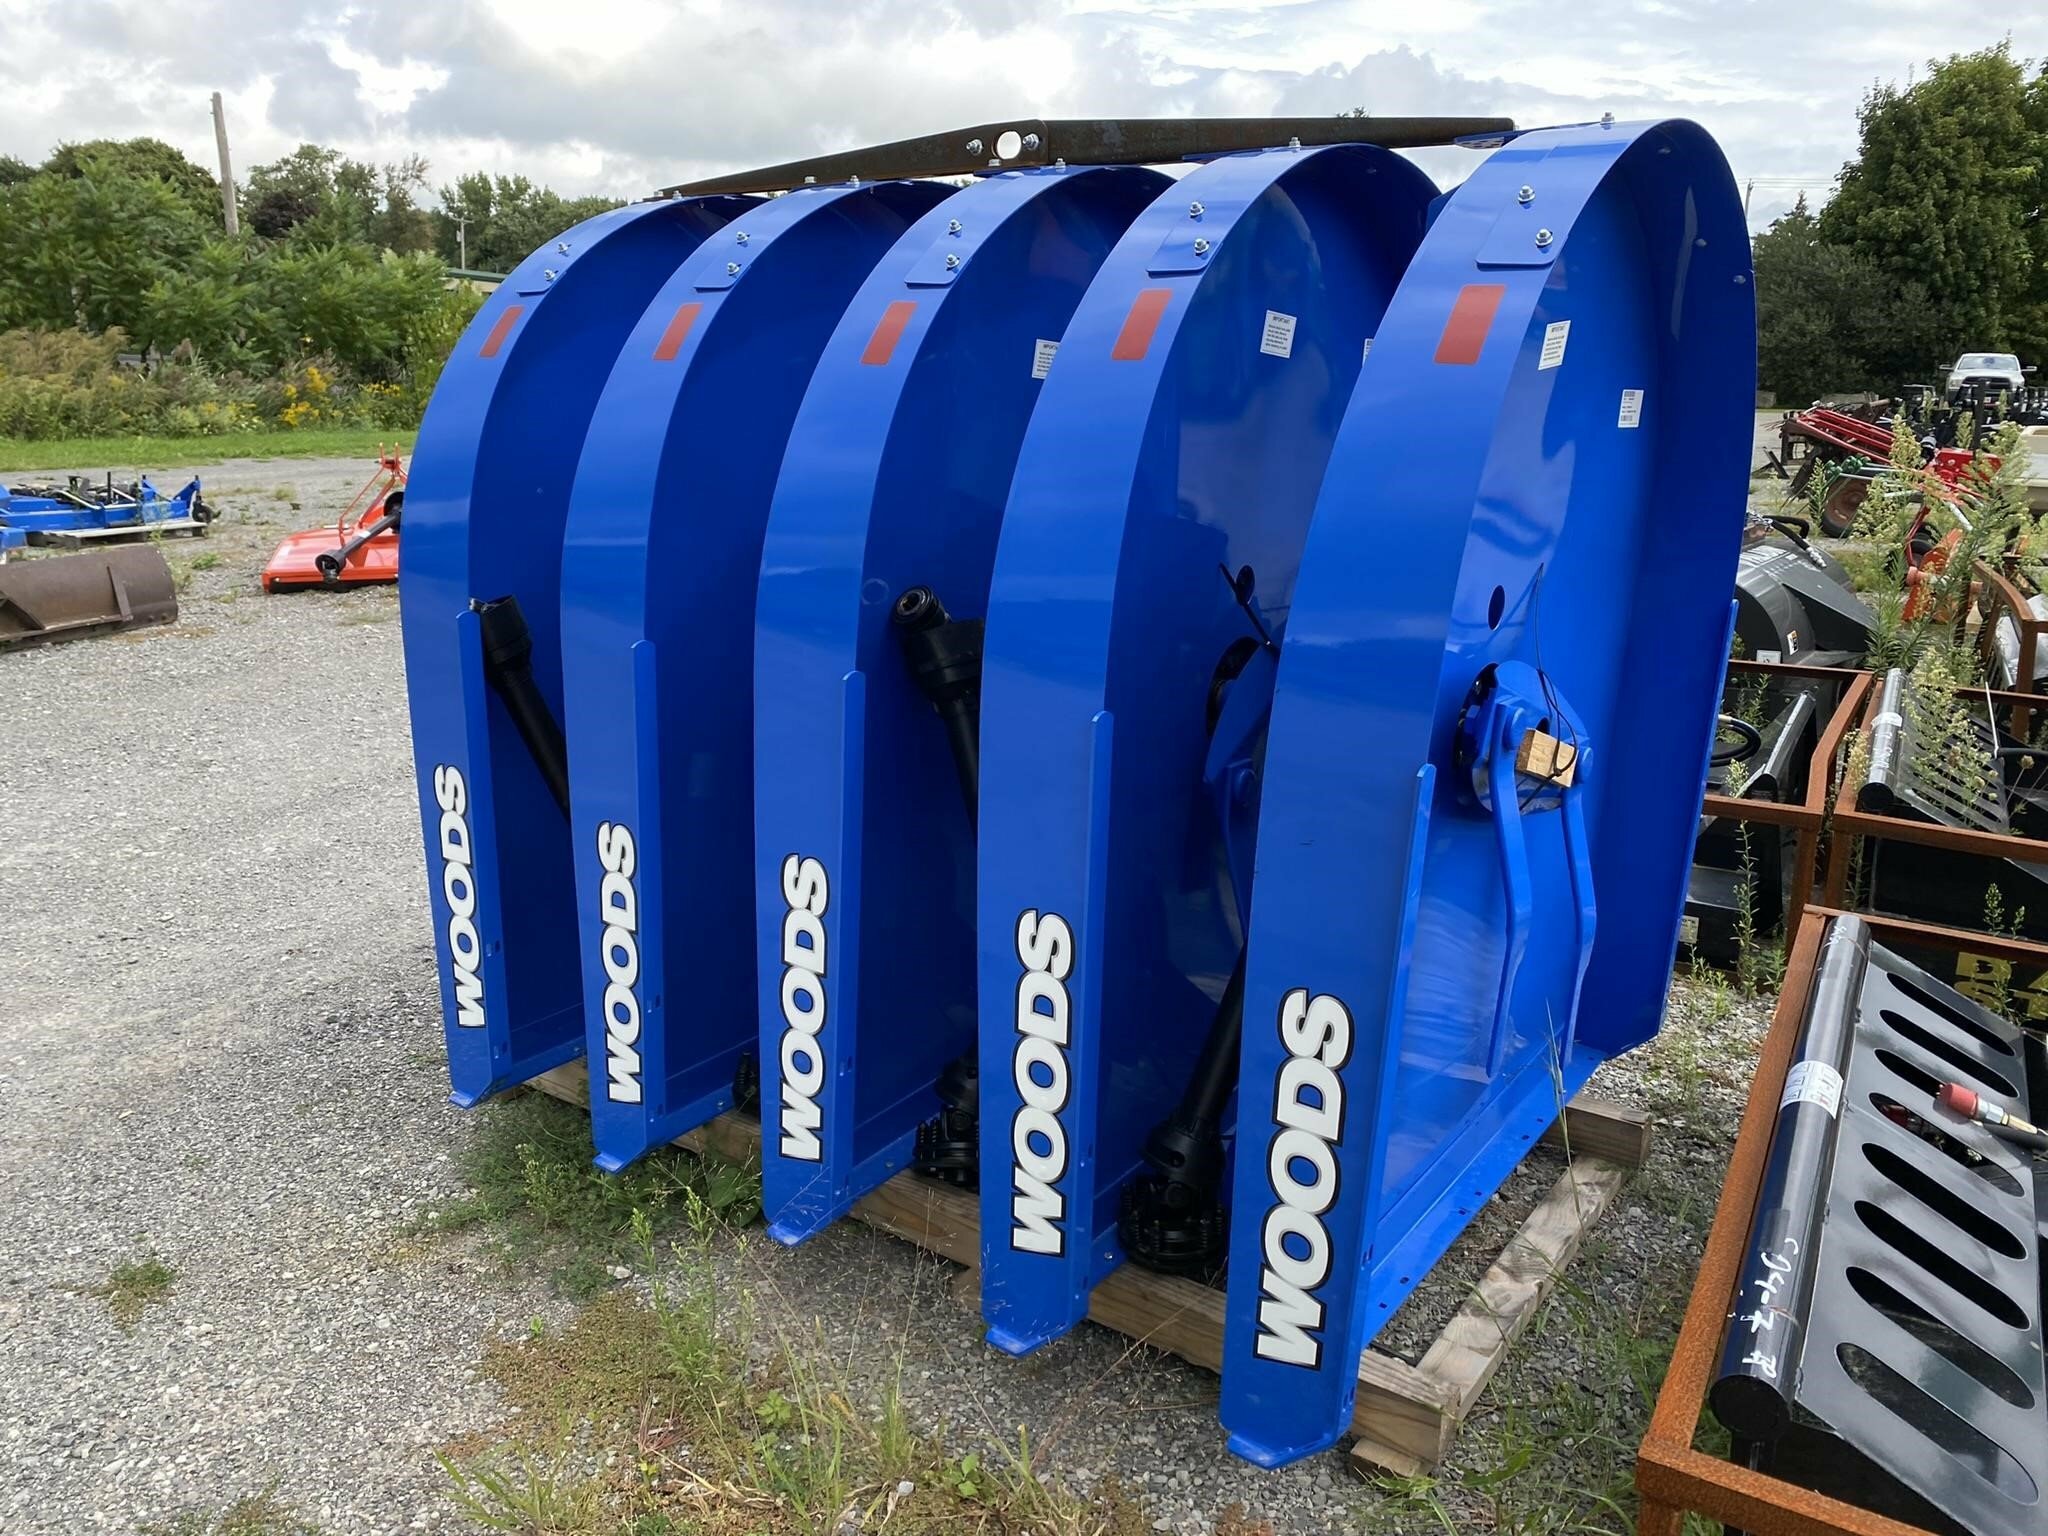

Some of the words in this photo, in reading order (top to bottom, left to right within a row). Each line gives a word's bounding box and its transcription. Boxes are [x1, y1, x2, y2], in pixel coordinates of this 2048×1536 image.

[433, 764, 486, 1027] WOODS
[597, 821, 641, 1104] WOODS
[781, 853, 828, 1161] WOODS
[1012, 909, 1073, 1255] WOODS
[1255, 988, 1351, 1368] WOODS
